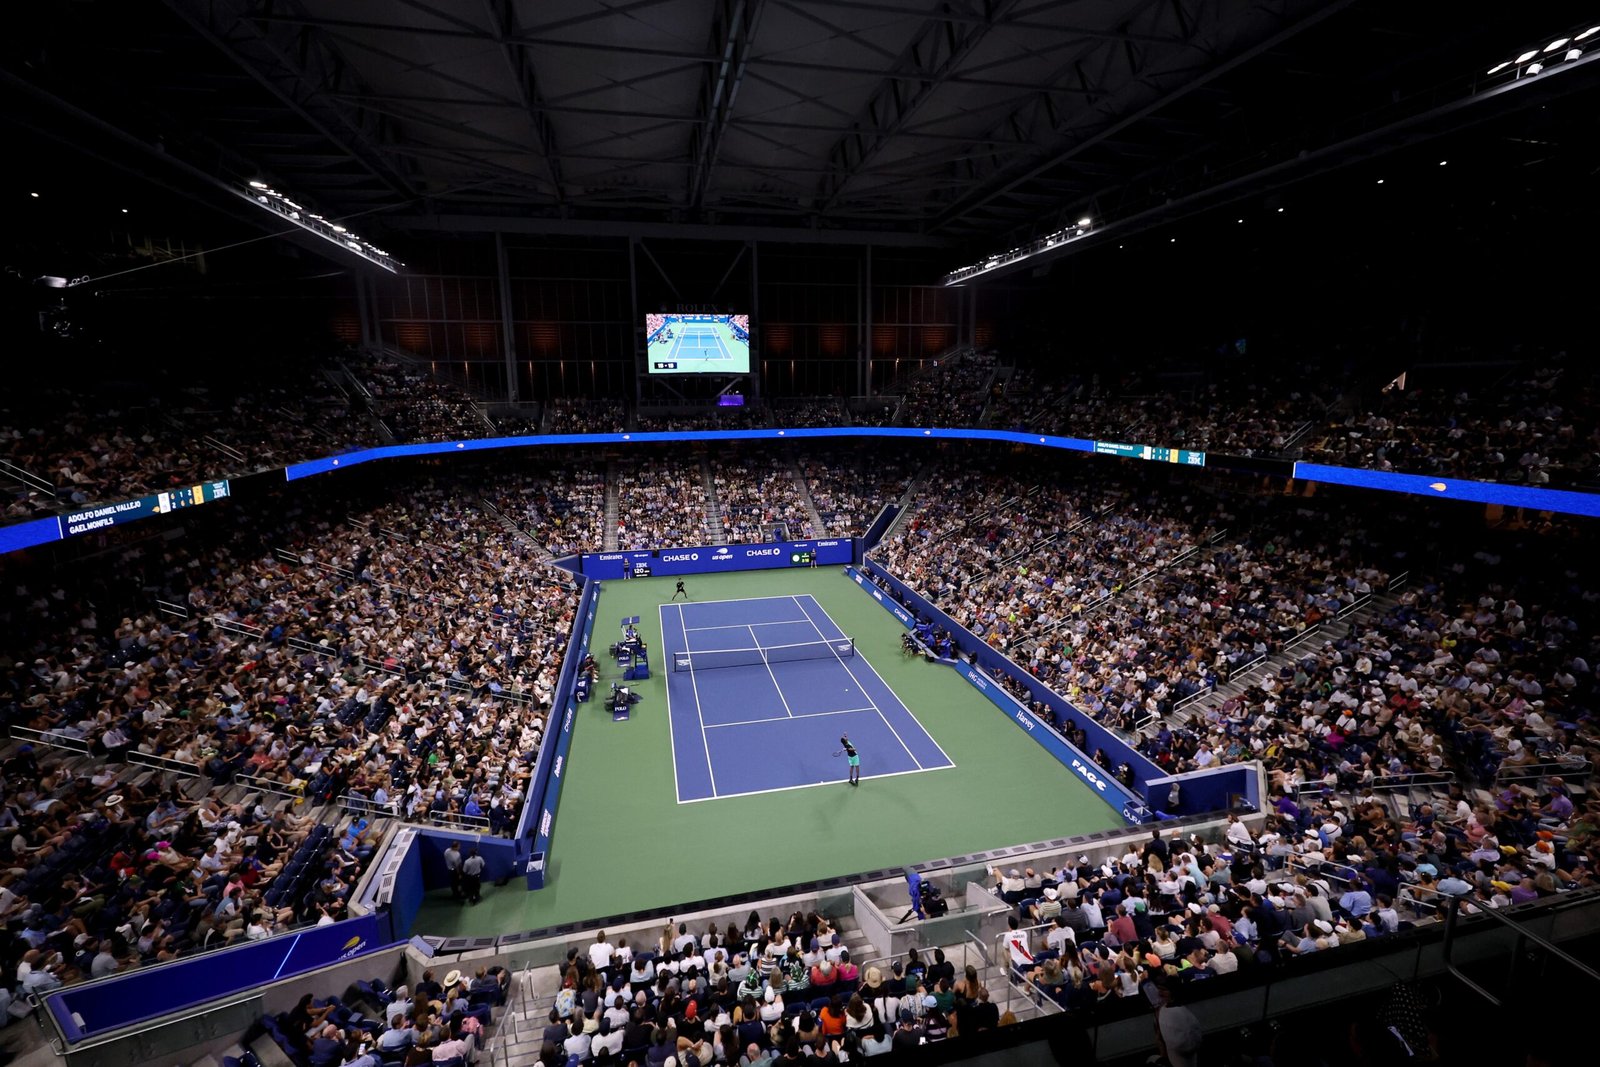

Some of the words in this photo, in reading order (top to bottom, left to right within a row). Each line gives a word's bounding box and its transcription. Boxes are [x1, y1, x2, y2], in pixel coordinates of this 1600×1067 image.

[68, 511, 94, 523] ADOLFO
[94, 506, 116, 517] DANIEL
[116, 501, 141, 512] VALLEJO
[69, 524, 88, 534] GAEL
[88, 517, 114, 530] MONFILS
[663, 554, 690, 562] CHASE
[746, 549, 772, 557] CHASE
[1016, 710, 1035, 731] Harvey
[347, 940, 367, 955] open
